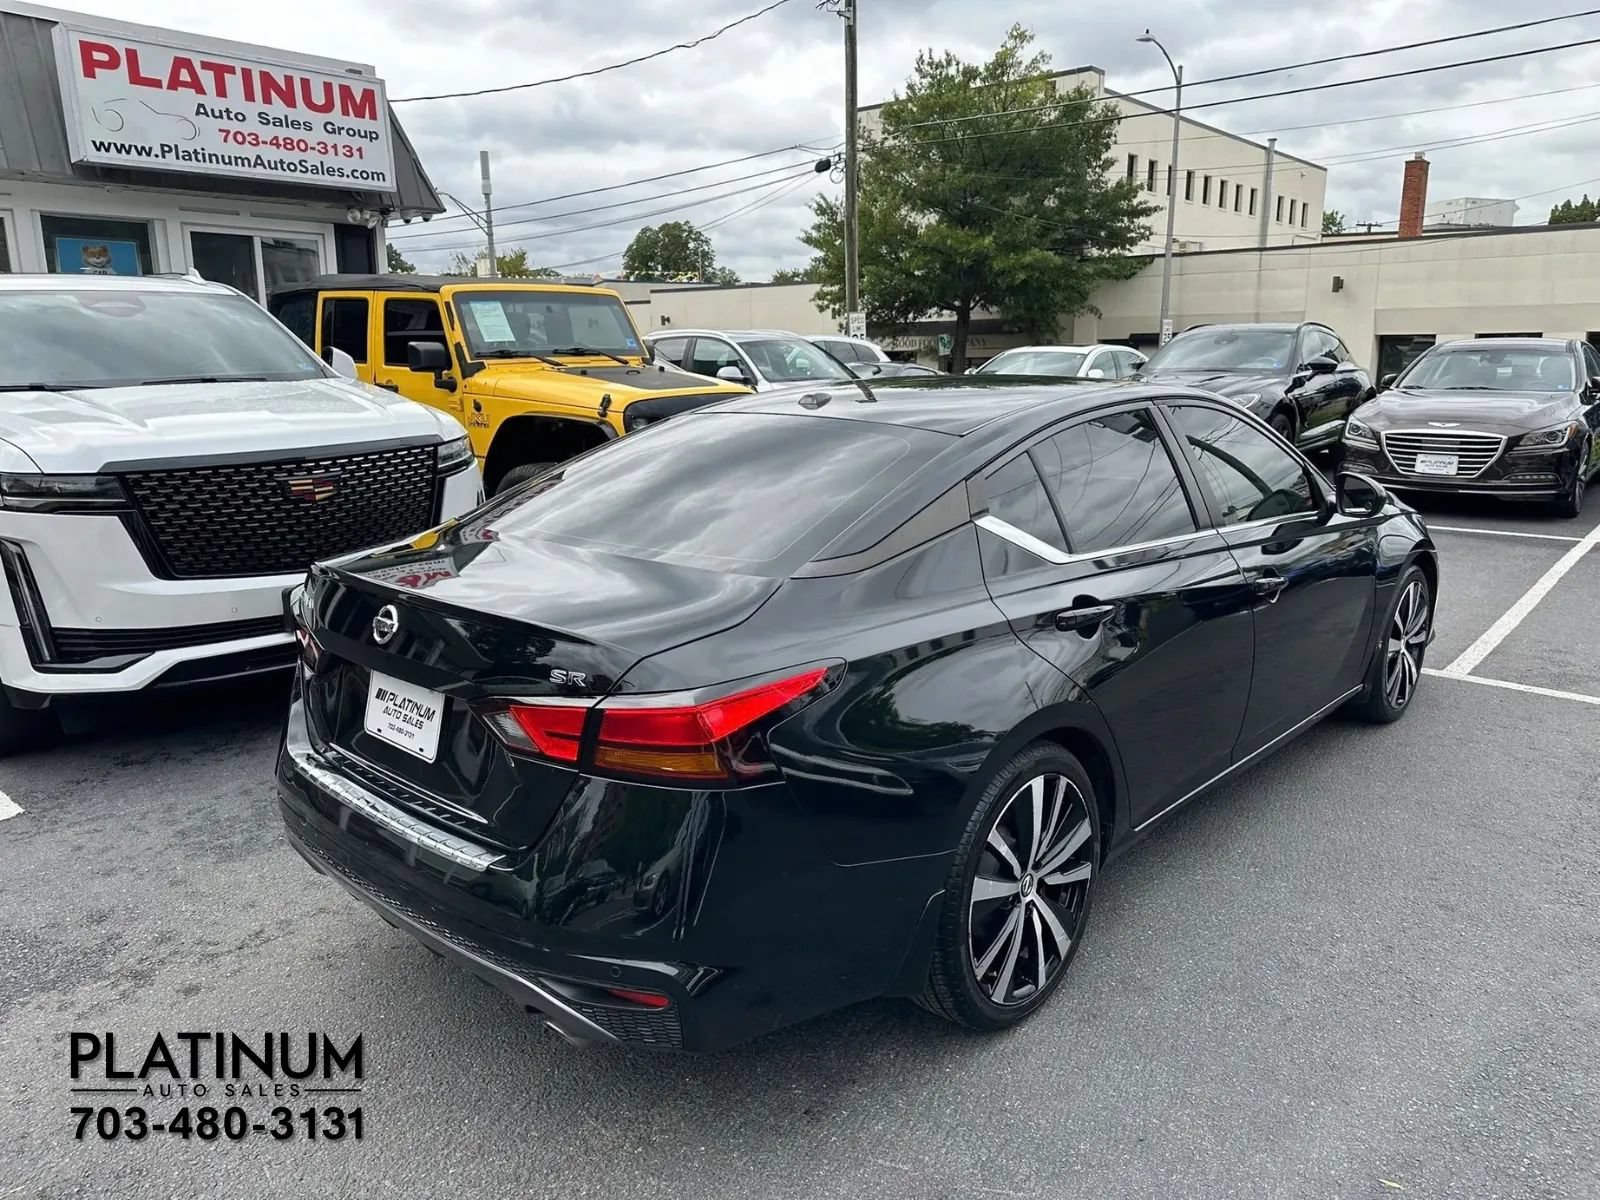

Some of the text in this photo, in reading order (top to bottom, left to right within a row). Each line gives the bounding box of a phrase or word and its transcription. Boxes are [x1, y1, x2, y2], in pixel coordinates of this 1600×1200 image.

[79, 40, 377, 120] PLATINUM
[195, 103, 379, 142] Auto Sales Group
[218, 128, 364, 160] 703-480-3131
[91, 140, 386, 182] www.PlatinumAutoSales.com
[549, 669, 586, 687] SR
[383, 706, 424, 730] AUTO SALES
[386, 692, 436, 722] PLATINUM
